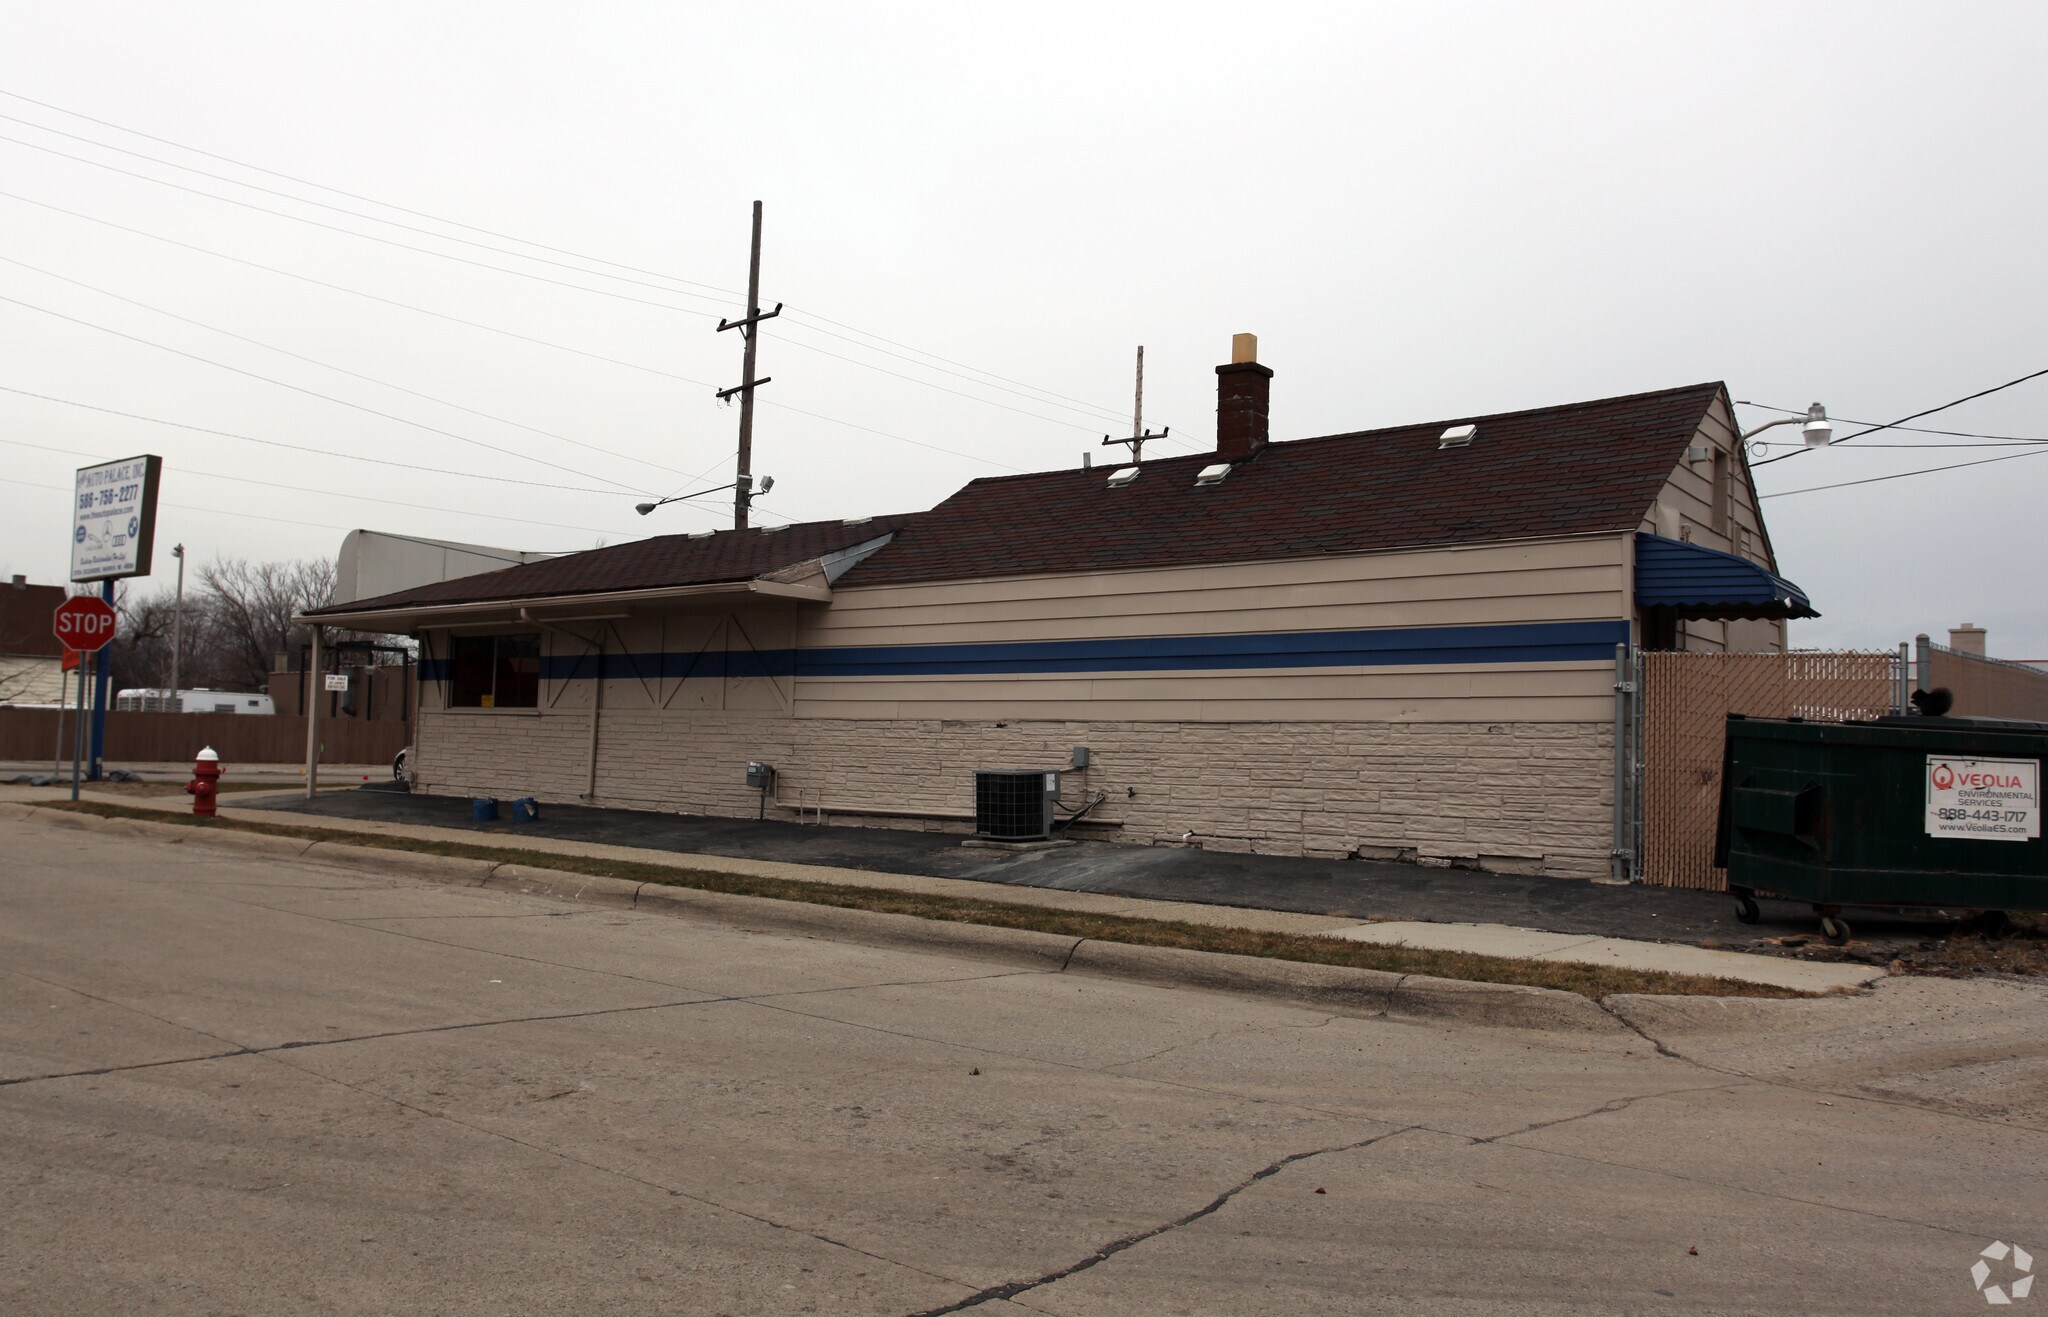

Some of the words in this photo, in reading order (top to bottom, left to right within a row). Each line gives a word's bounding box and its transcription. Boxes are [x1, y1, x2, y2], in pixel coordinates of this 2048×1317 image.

[59, 612, 112, 634] STOP
[1958, 773, 2022, 788] VEOLIA
[1958, 790, 2034, 800] ENVIRONMENTAL
[1958, 798, 2003, 807] SERVICES
[1938, 807, 2027, 823] 888-443-1717
[1939, 823, 2027, 833] www.VeoliaES.com
